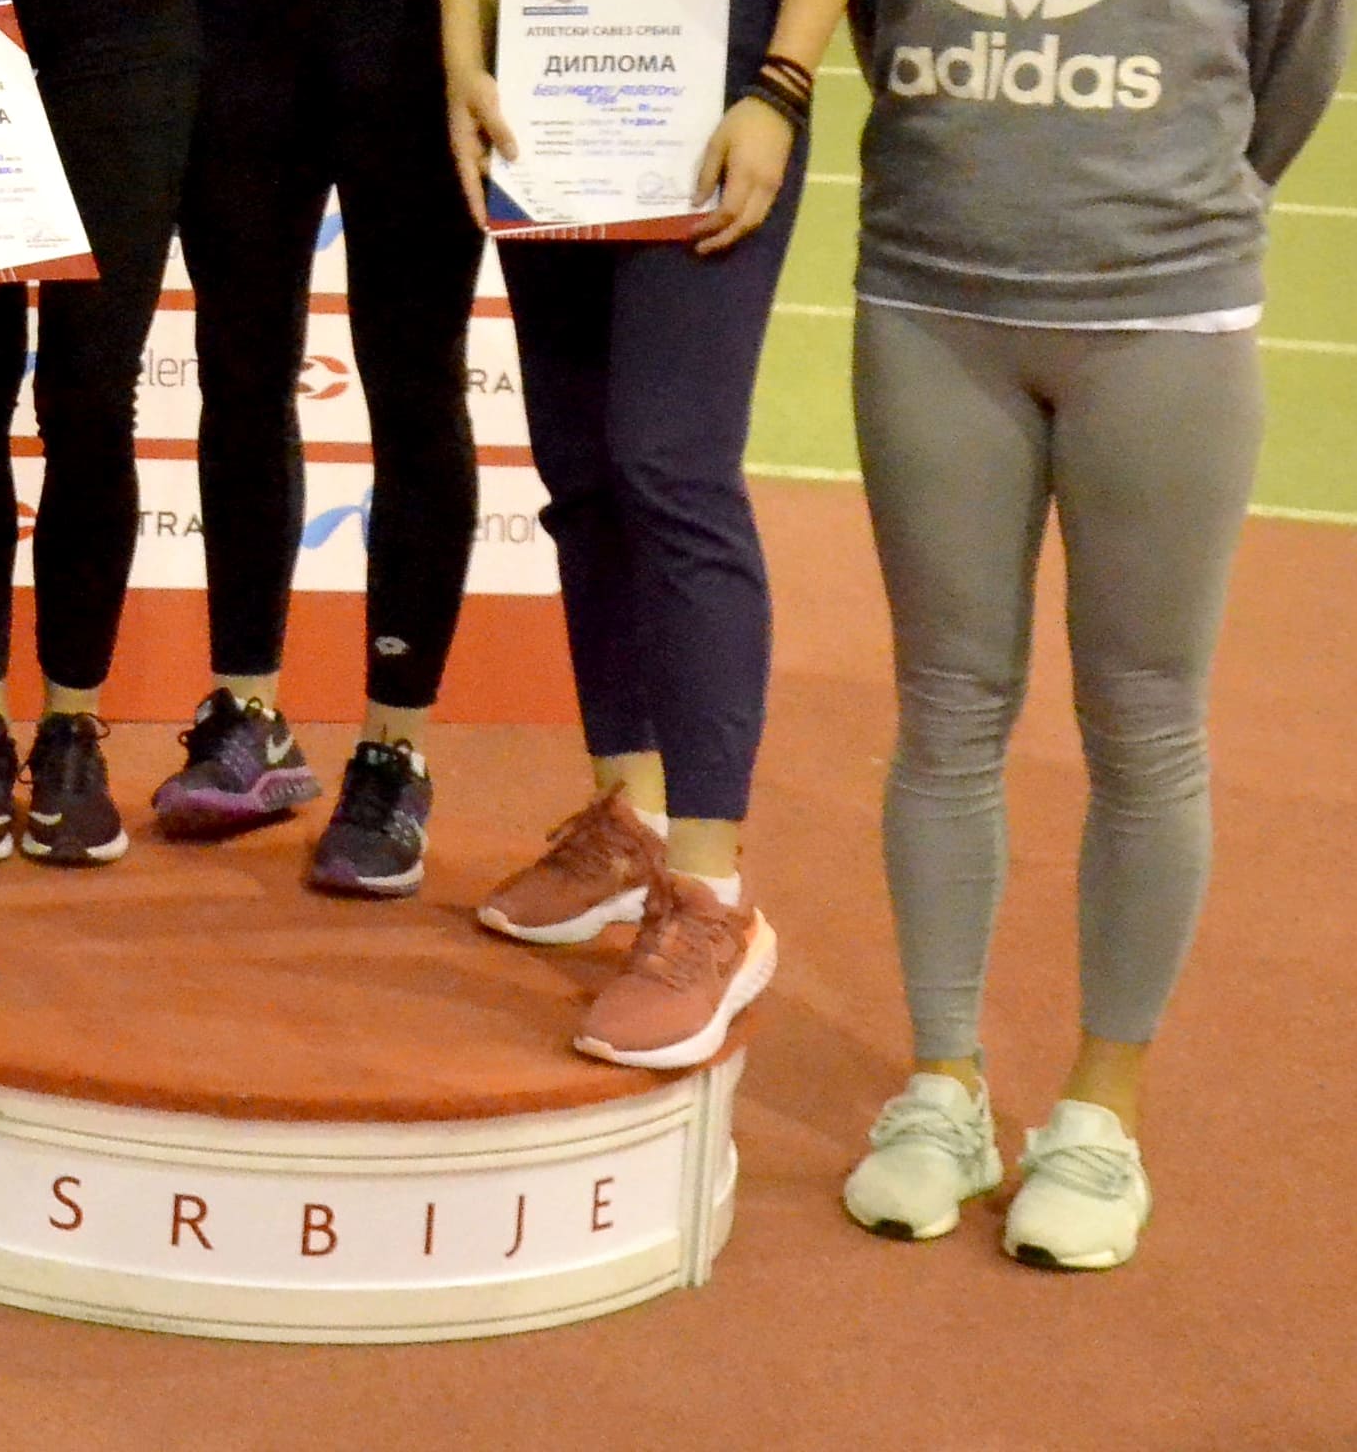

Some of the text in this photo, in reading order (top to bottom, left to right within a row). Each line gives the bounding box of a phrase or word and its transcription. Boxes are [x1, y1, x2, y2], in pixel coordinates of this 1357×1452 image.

[544, 55, 676, 76] ДИПЛОМА
[890, 31, 1163, 110] adidas
[47, 1174, 617, 1258] SRBIJE
